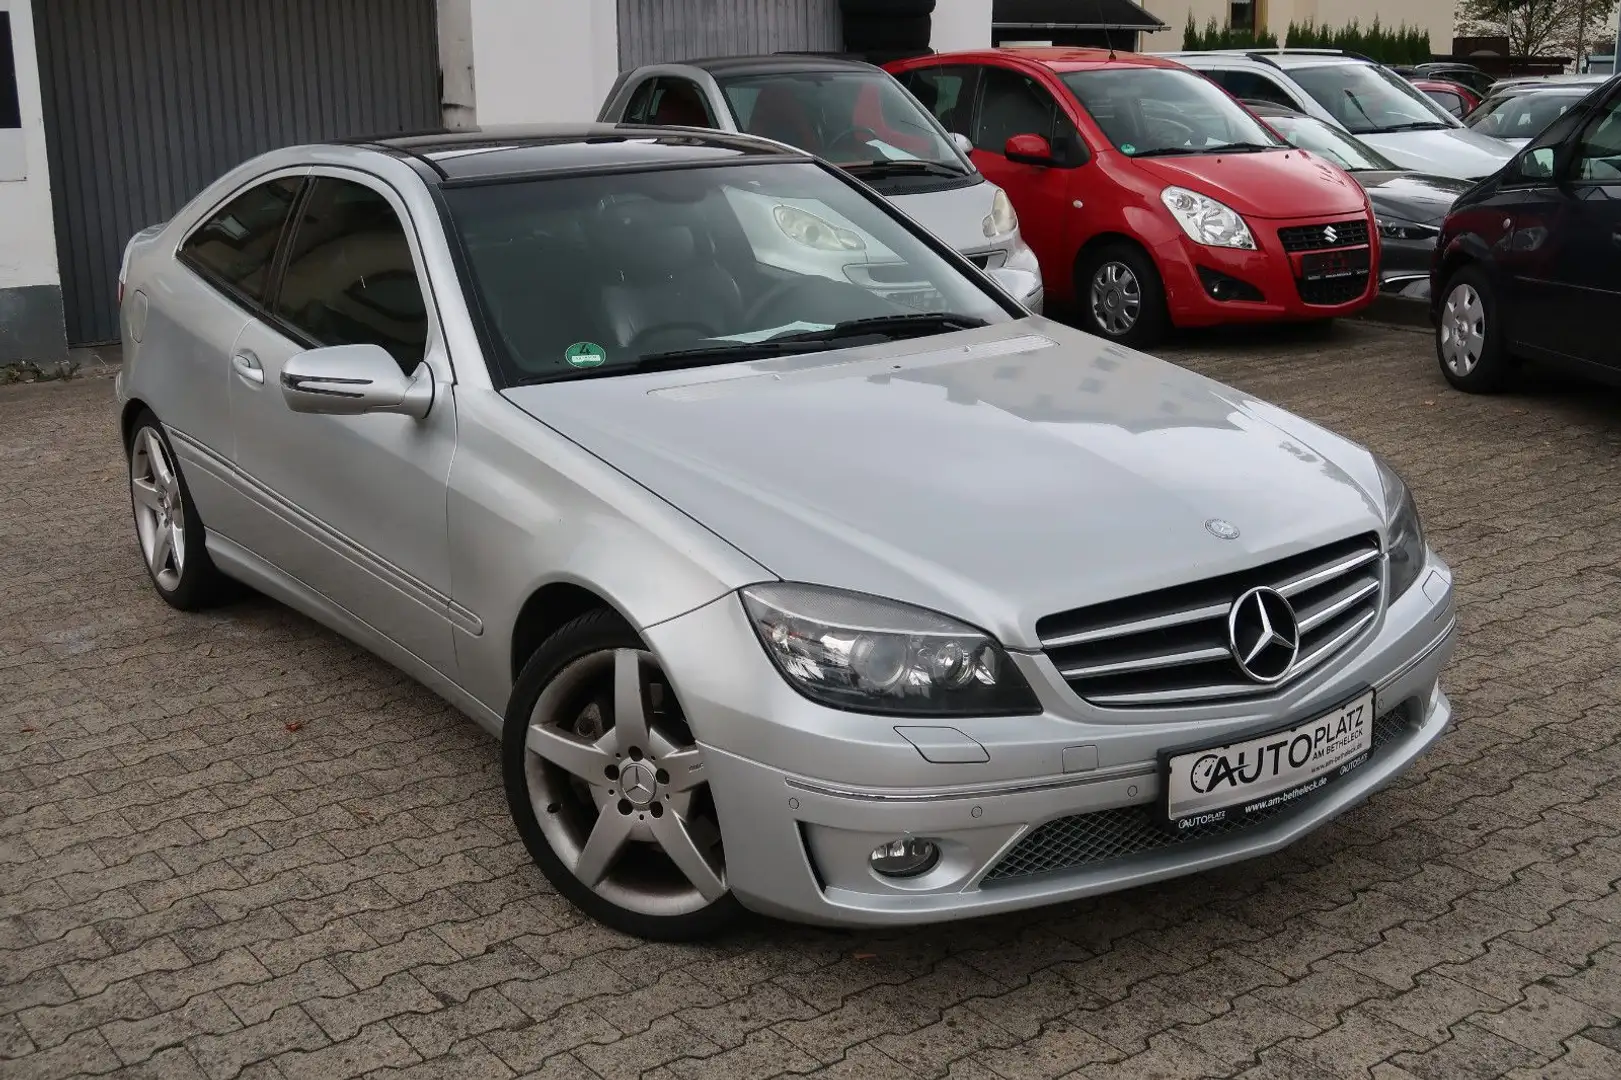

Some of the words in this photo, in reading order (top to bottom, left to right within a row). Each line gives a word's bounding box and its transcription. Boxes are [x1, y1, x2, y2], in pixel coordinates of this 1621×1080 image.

[1204, 705, 1364, 793] AUTOPLATZ
[1312, 749, 1325, 761] AM
[1326, 728, 1363, 755] BETHELECK
[1245, 776, 1327, 813] www.am-betheleck.de
[1181, 810, 1226, 829] AUTOPLATZ
